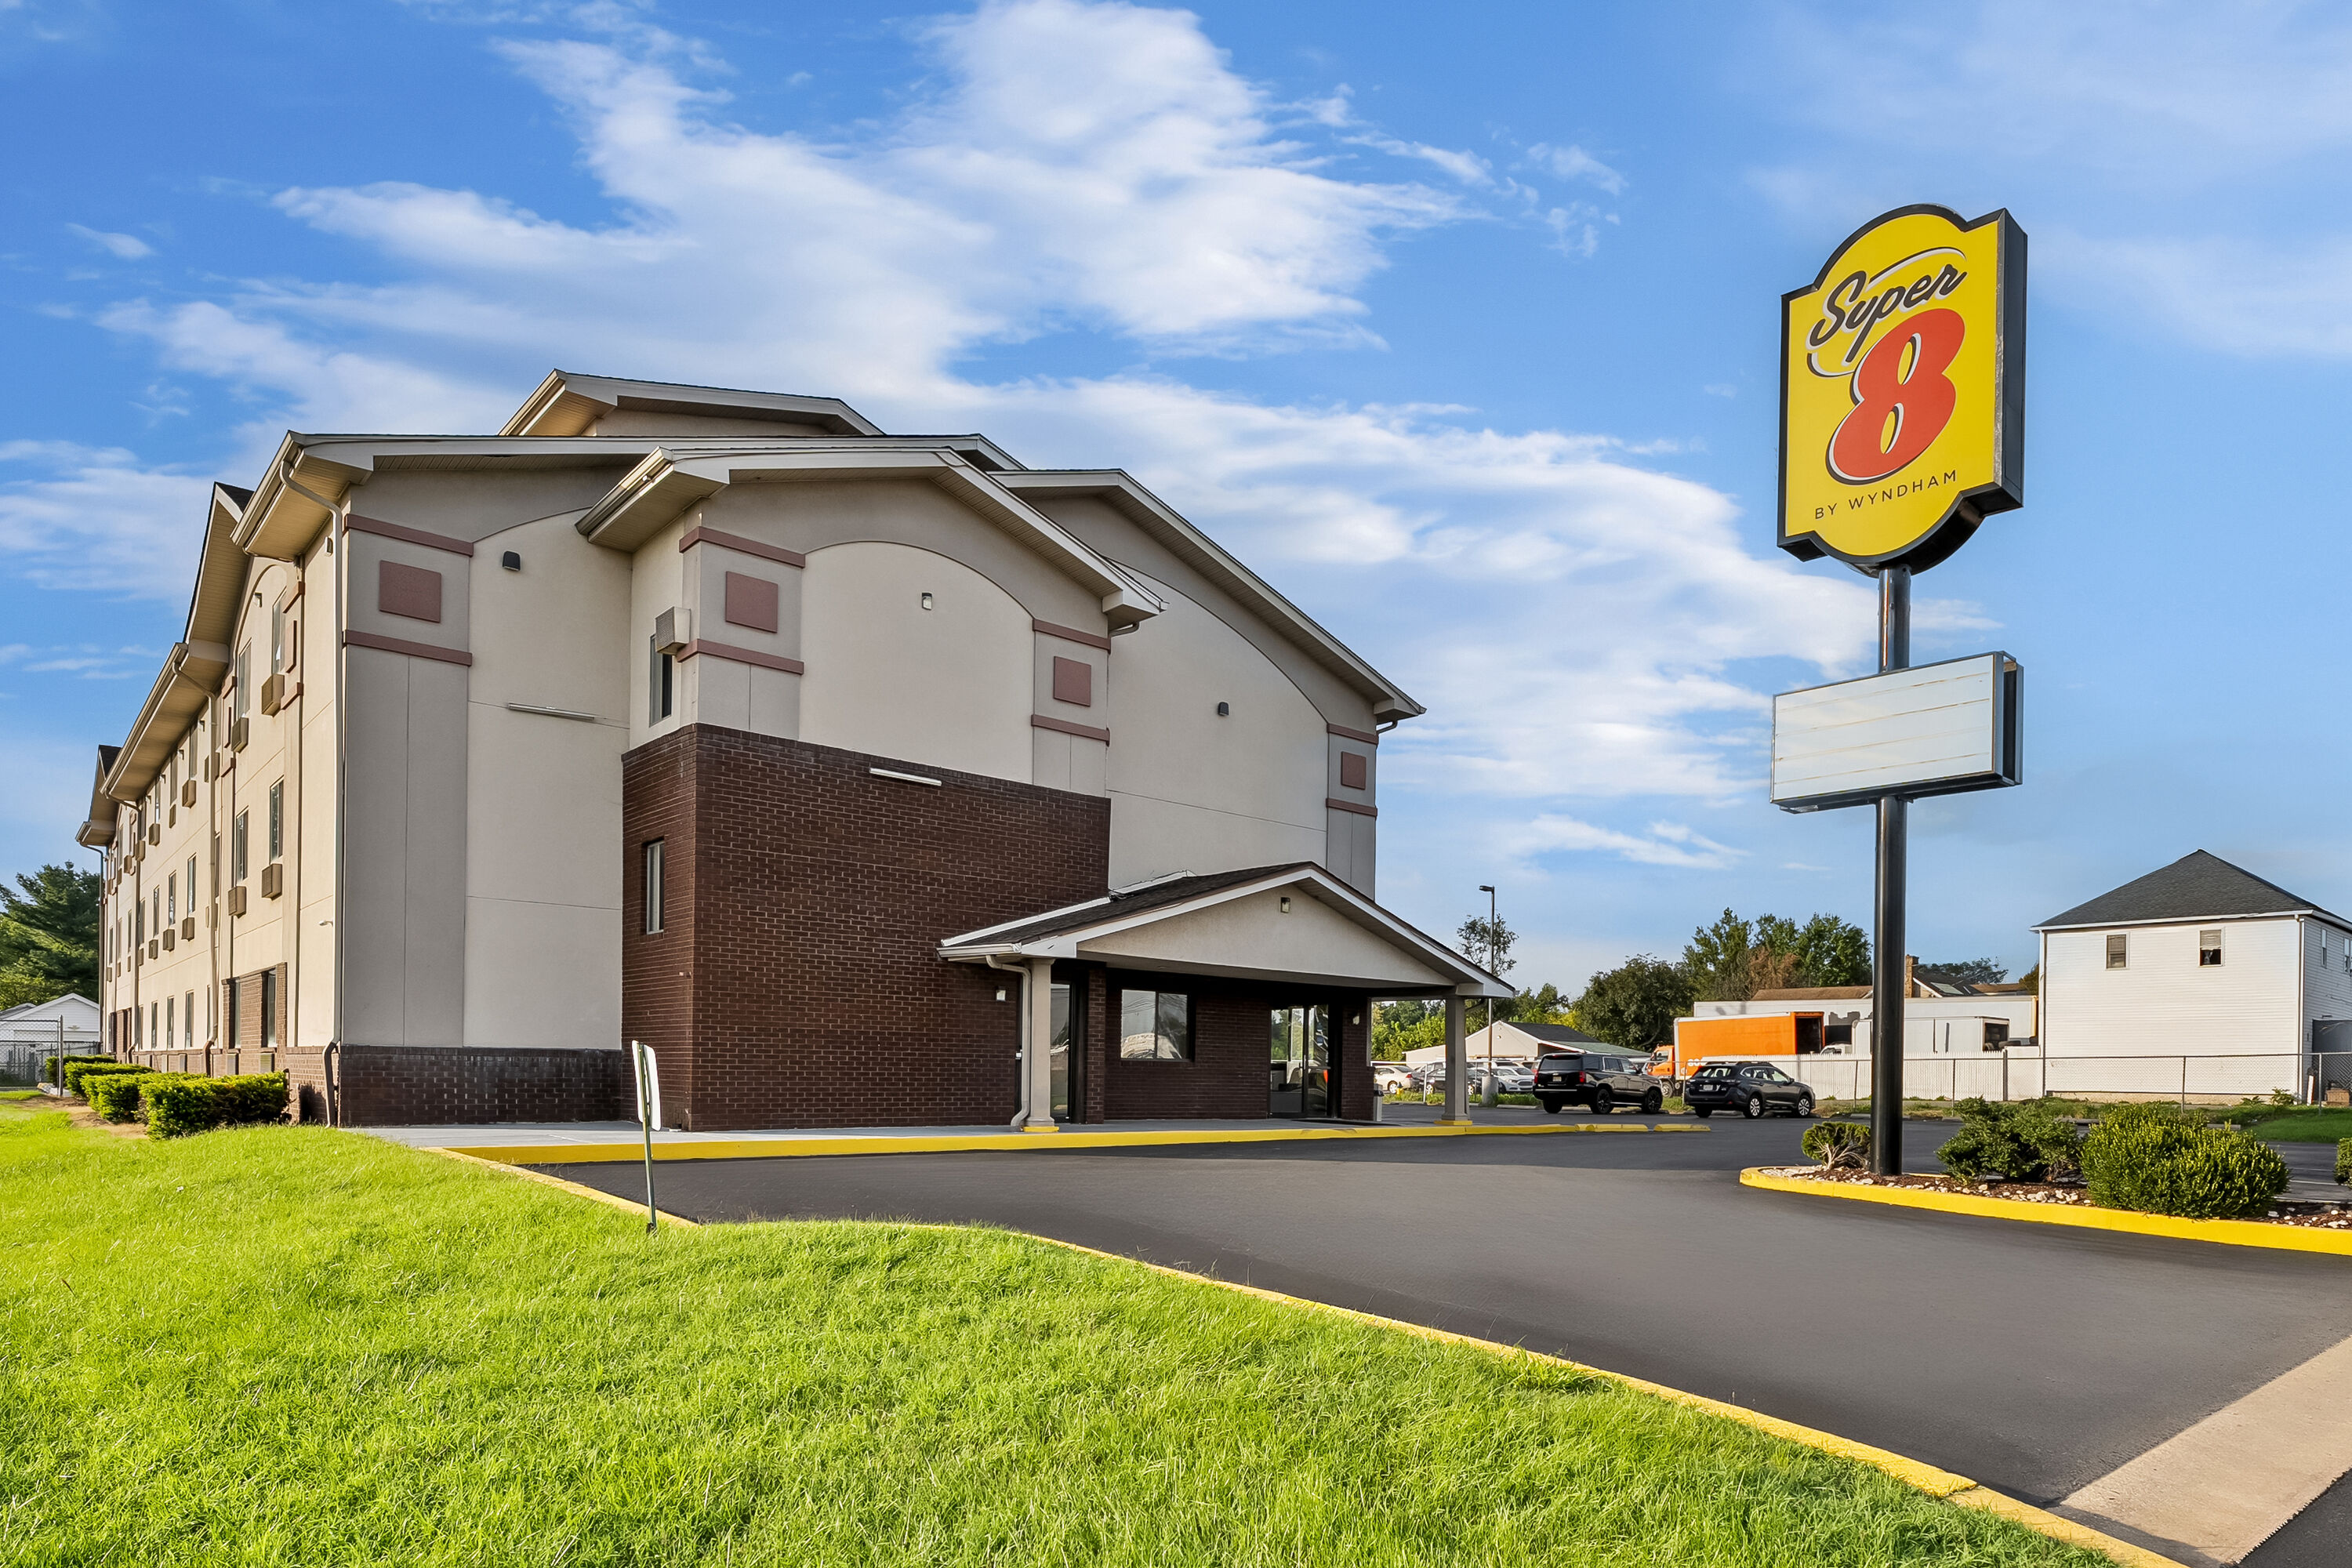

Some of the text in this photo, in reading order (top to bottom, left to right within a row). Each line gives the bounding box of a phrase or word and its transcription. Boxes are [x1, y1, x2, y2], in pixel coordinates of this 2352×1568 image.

[1808, 263, 1967, 364] Super
[1825, 308, 1965, 486] 8
[1815, 470, 1957, 520] BY WYNDHAM
